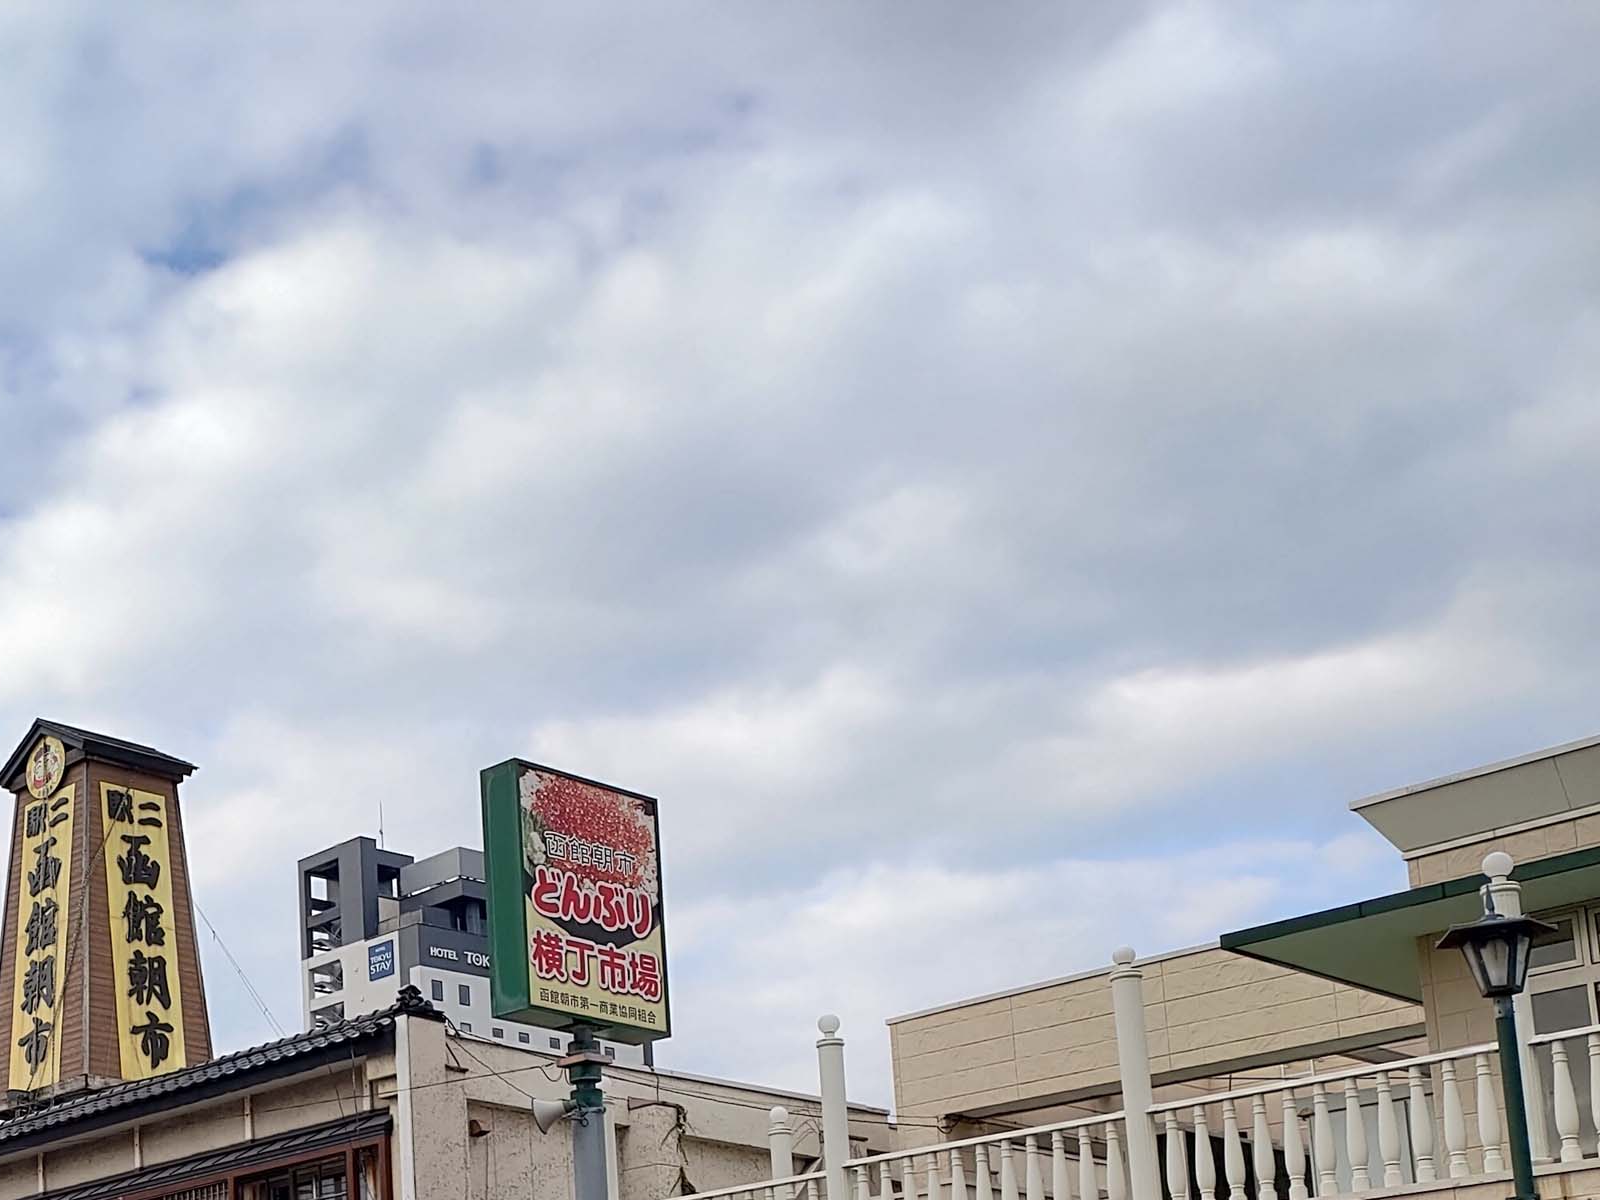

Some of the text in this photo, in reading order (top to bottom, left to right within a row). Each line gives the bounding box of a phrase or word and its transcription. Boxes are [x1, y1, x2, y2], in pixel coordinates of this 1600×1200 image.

[544, 831, 636, 877] 函館朝市
[531, 865, 651, 939] どんぶり
[18, 836, 62, 1075] 函館朝市
[117, 834, 175, 1070] 函館朝市
[370, 952, 393, 964] TOKYU
[370, 960, 393, 975] STAY
[429, 946, 459, 961] HOTEL
[531, 927, 663, 1003] 横丁市場
